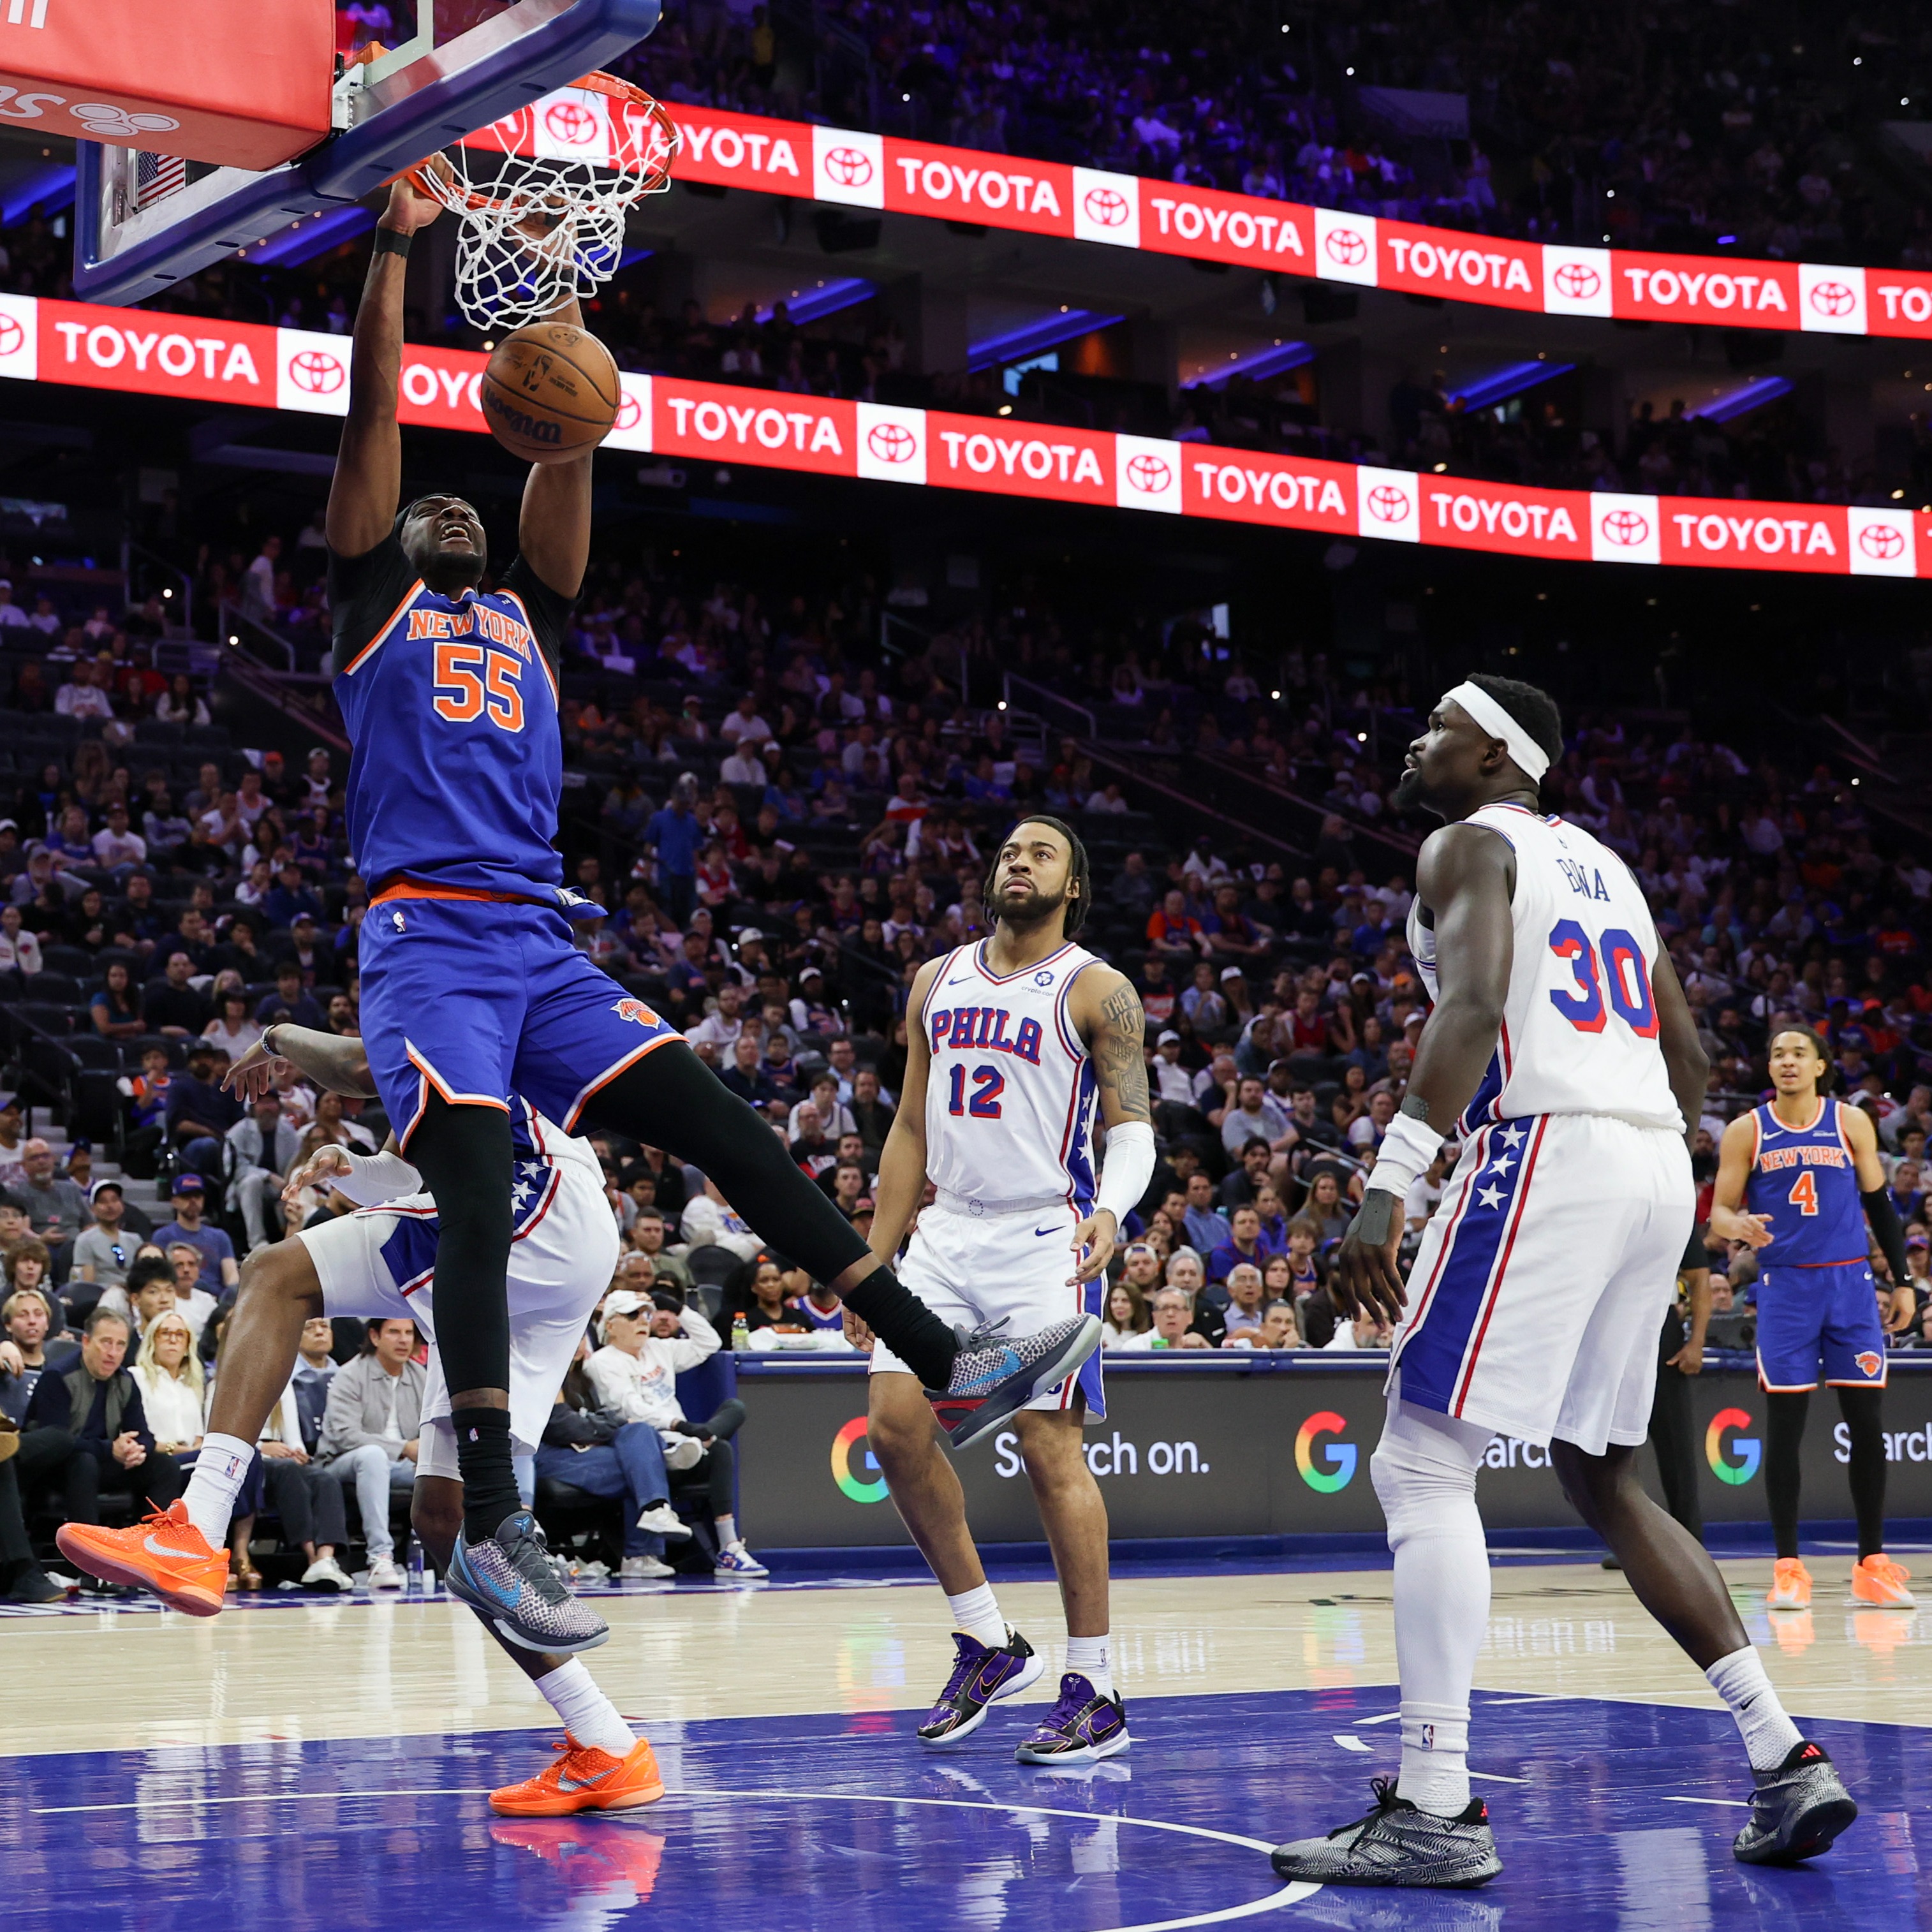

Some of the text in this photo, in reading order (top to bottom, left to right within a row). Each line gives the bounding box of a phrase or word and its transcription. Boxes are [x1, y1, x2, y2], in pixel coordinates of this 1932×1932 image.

[624, 115, 799, 177] TOYOTA
[897, 158, 1061, 217] TOYOTA
[1151, 198, 1304, 256] TOYOTA
[1387, 239, 1532, 293] TOYOTA
[1624, 268, 1787, 312] TOYOTA
[1877, 286, 1932, 322] TO
[55, 321, 260, 385] TOYOTA
[667, 398, 843, 455] TOYOTA
[940, 431, 1103, 485] TOYOTA
[1193, 462, 1346, 515] TOYOTA
[1430, 493, 1577, 542] TOYOTA
[1672, 514, 1836, 556] TOYOTA
[406, 602, 532, 665] NEW YORK
[433, 642, 525, 733] 55
[1103, 991, 1128, 1019] THE
[1549, 918, 1660, 1040] 30
[931, 1007, 1042, 1066] PHILA
[948, 1063, 1005, 1119] 12
[1759, 1146, 1846, 1173] NEW YORK
[1788, 1170, 1818, 1216] 4
[994, 1431, 1210, 1478] Sch on.
